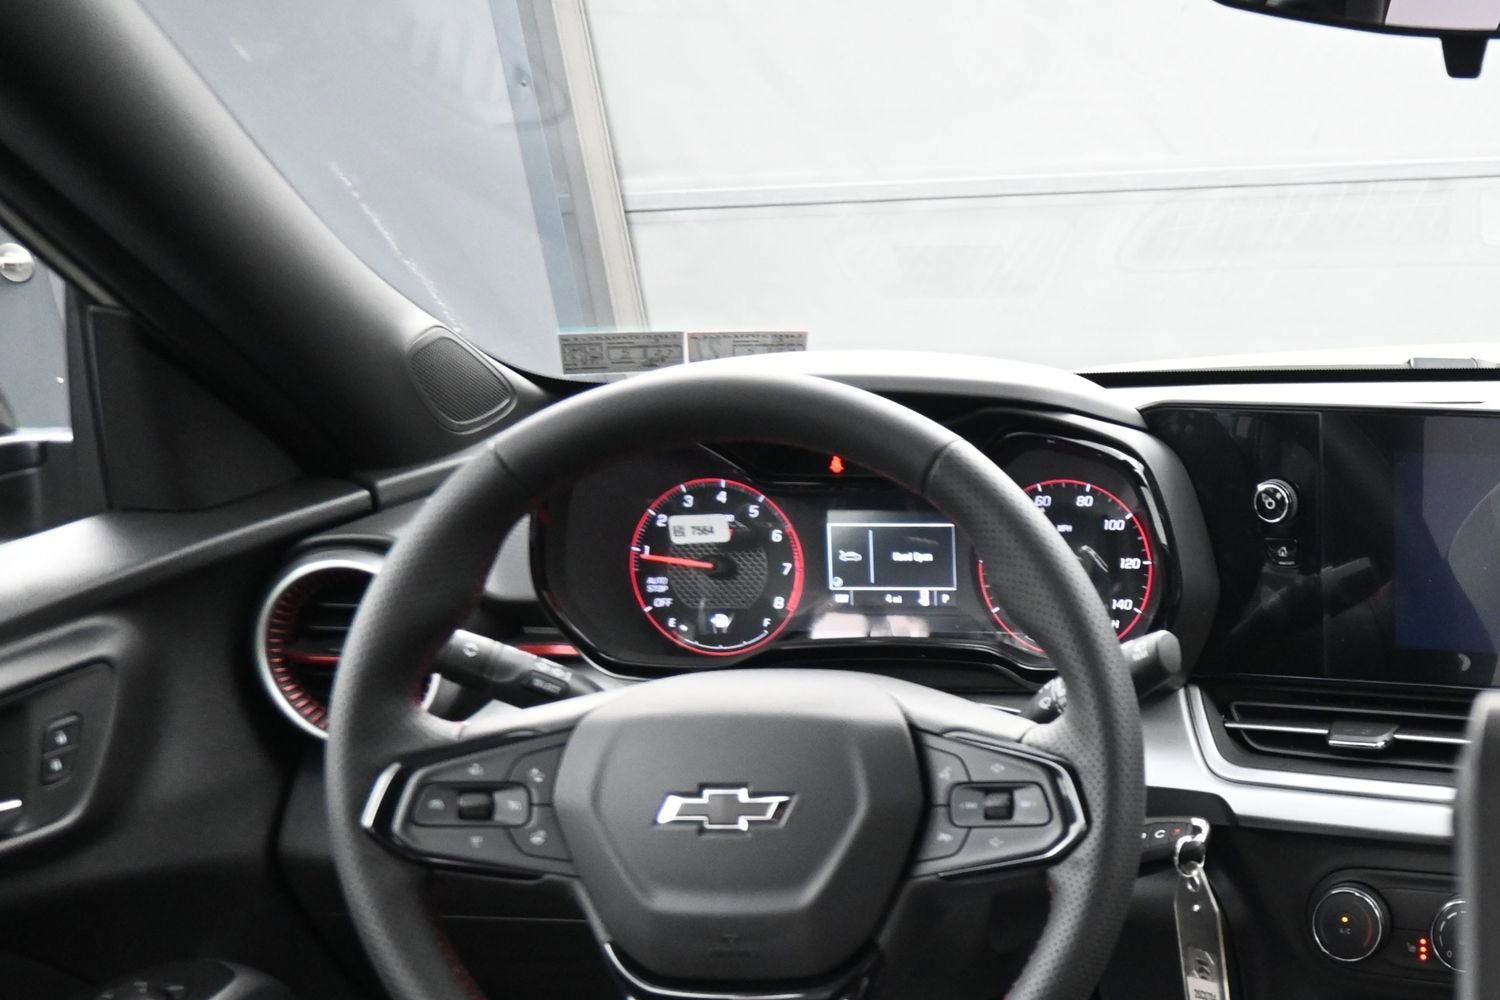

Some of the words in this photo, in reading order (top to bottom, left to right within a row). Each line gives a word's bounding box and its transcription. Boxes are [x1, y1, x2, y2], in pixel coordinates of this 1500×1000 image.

[683, 495, 694, 508] 3
[716, 491, 728, 503] 4
[1034, 495, 1052, 507] 60
[1076, 495, 1094, 507] 80
[748, 505, 760, 518] 5
[656, 514, 668, 527] 2
[1104, 519, 1126, 531] 100
[771, 529, 783, 542] 6
[643, 545, 650, 556] 1
[782, 562, 792, 575] 7
[1120, 558, 1141, 569] 120
[653, 598, 673, 607] OFF
[773, 596, 785, 609] 8
[1112, 599, 1134, 610] 140
[668, 618, 677, 627] E
[763, 618, 771, 627] F
